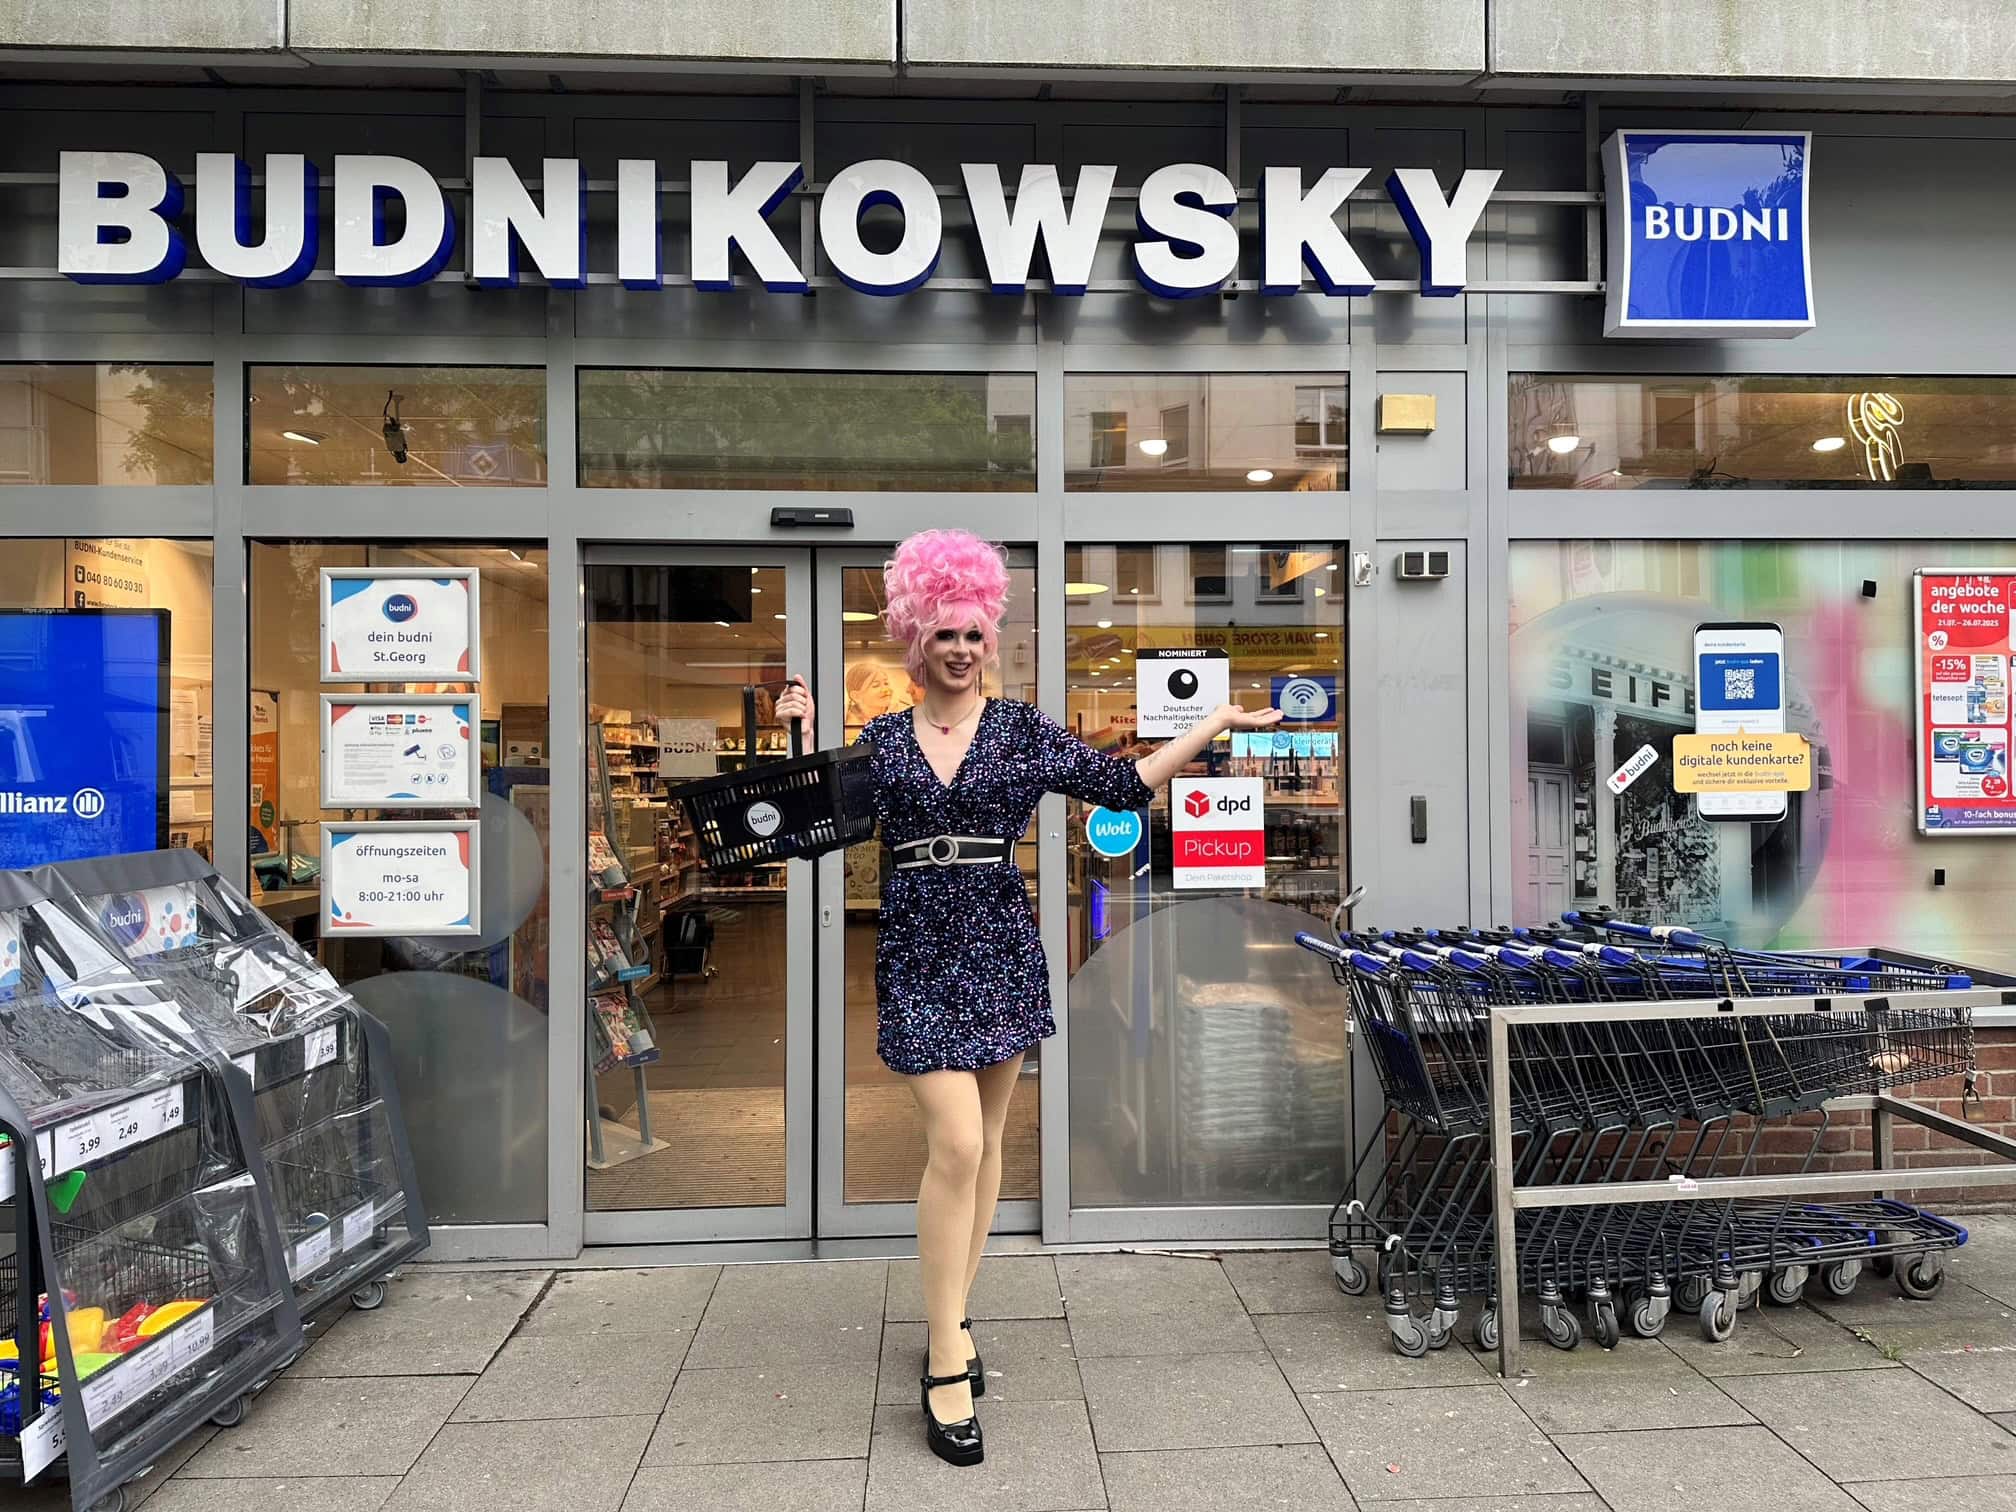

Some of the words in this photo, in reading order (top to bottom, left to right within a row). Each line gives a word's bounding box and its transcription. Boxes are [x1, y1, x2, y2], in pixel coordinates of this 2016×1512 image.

[58, 150, 1503, 297] BUDNIKOWSKY
[1645, 206, 1788, 242] BUDNI
[86, 571, 102, 585] 040
[1931, 586, 1999, 599] angebote
[388, 604, 412, 612] budni
[1931, 600, 1953, 614] der
[1960, 600, 2005, 614] woche
[368, 631, 394, 643] dein
[397, 631, 433, 643] budni
[373, 651, 426, 664] St.Georg
[1158, 649, 1208, 658] NOMINIERT
[1935, 659, 1967, 670] -15%
[1933, 695, 1963, 703] tetesept
[1163, 704, 1204, 713] Deutscher
[1110, 715, 1136, 725] Kitc
[1711, 740, 1738, 752] noch
[1742, 740, 1773, 752] keine
[1626, 749, 1654, 777] budni
[1679, 755, 1723, 769] digitale
[1726, 753, 1805, 766] kundenkarte?
[0, 791, 68, 814] llianz
[1216, 795, 1251, 815] dpd
[751, 811, 777, 825] budni
[1096, 820, 1132, 837] Wolt
[356, 845, 447, 859] öffnungszeiten
[1184, 838, 1252, 860] Pickup
[382, 874, 419, 883] mo-sa
[1185, 872, 1205, 882] Dein
[1207, 872, 1253, 883] Paketshop
[358, 891, 421, 902] 8:00-21:00
[424, 891, 445, 902] uhr
[110, 908, 142, 928] budni
[162, 1106, 180, 1123] 1,49
[118, 1122, 139, 1140] 2,49
[79, 1136, 101, 1155] 3,99
